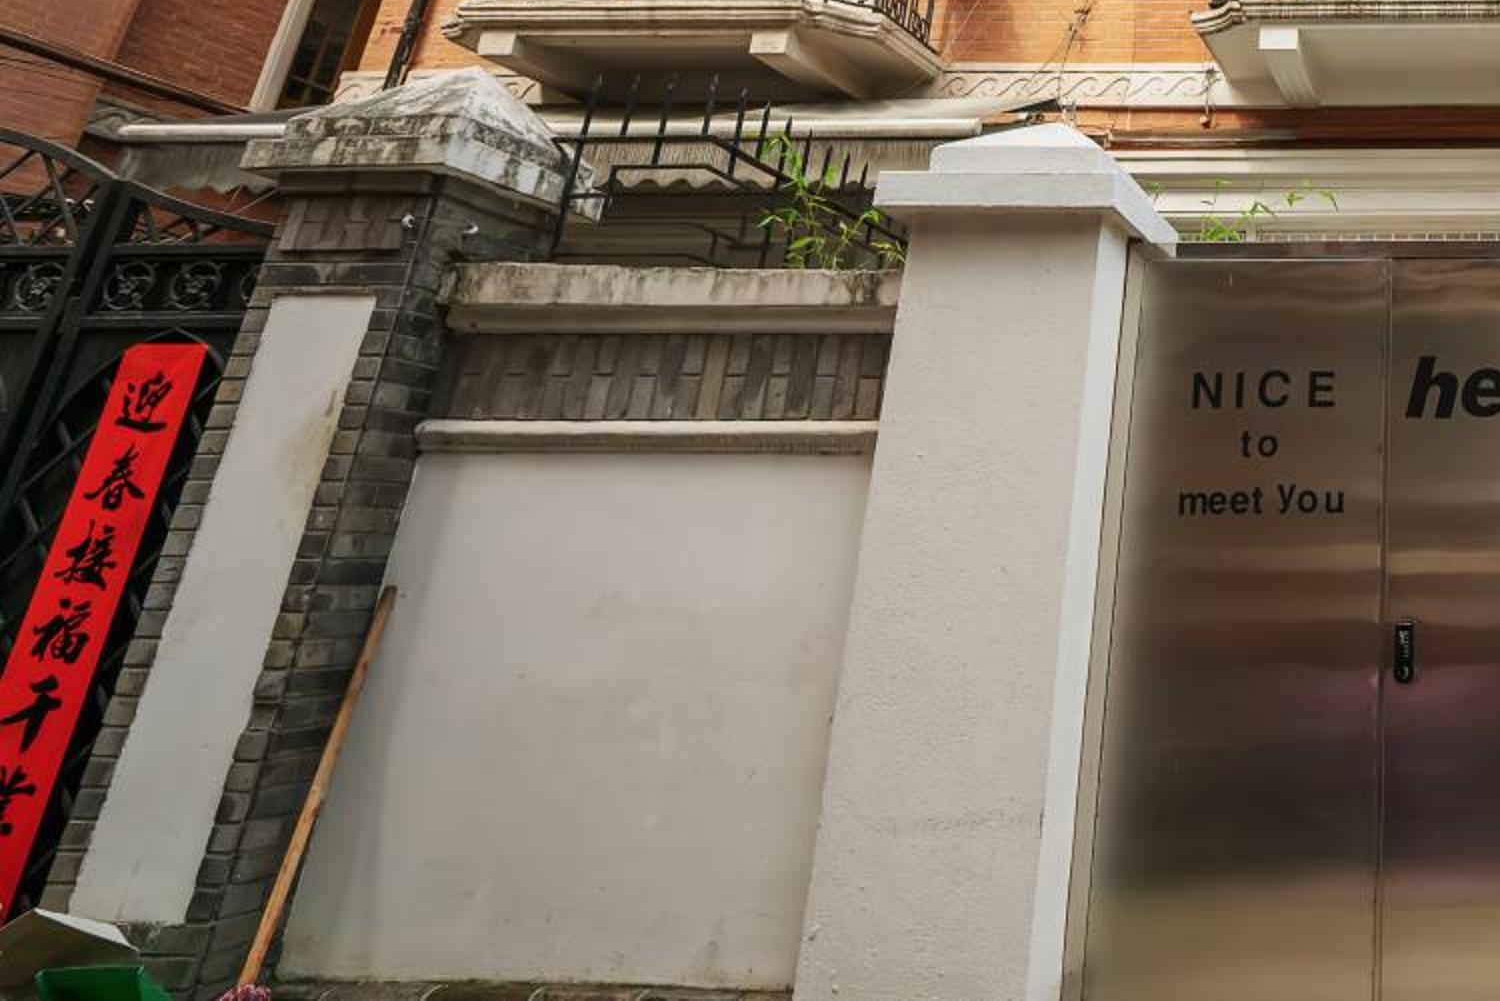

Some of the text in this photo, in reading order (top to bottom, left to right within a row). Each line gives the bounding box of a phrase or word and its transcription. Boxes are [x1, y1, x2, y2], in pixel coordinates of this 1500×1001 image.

[1191, 370, 1336, 409] NICE
[1241, 430, 1279, 458] to
[1178, 486, 1264, 515] meet
